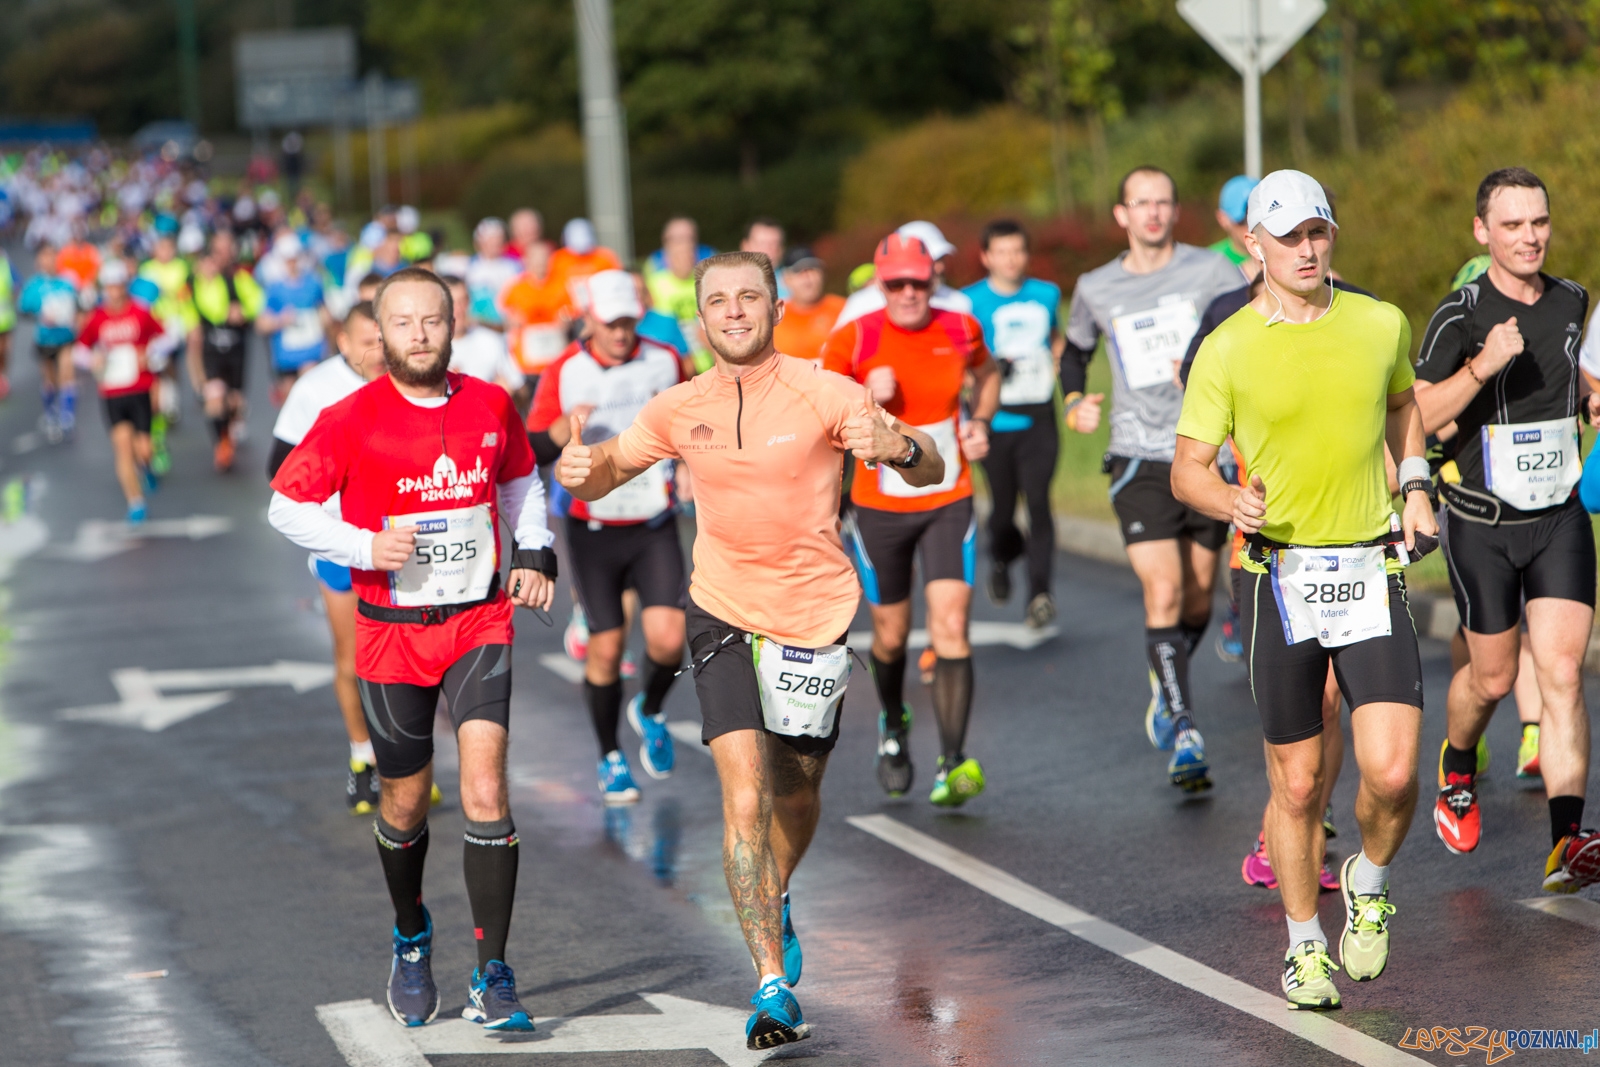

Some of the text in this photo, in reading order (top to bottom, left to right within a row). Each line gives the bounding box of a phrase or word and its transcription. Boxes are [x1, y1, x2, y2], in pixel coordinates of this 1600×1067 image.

[1517, 450, 1563, 472] 6221
[1528, 474, 1557, 484] Maciej
[417, 521, 446, 532] 17.PKO
[415, 540, 477, 565] 5925
[434, 567, 465, 577] Paweł
[1304, 581, 1365, 603] 2880
[1321, 608, 1349, 618] Marek
[784, 650, 812, 660] 17.PKO
[776, 671, 836, 698] 5788
[787, 697, 817, 711] Paweł
